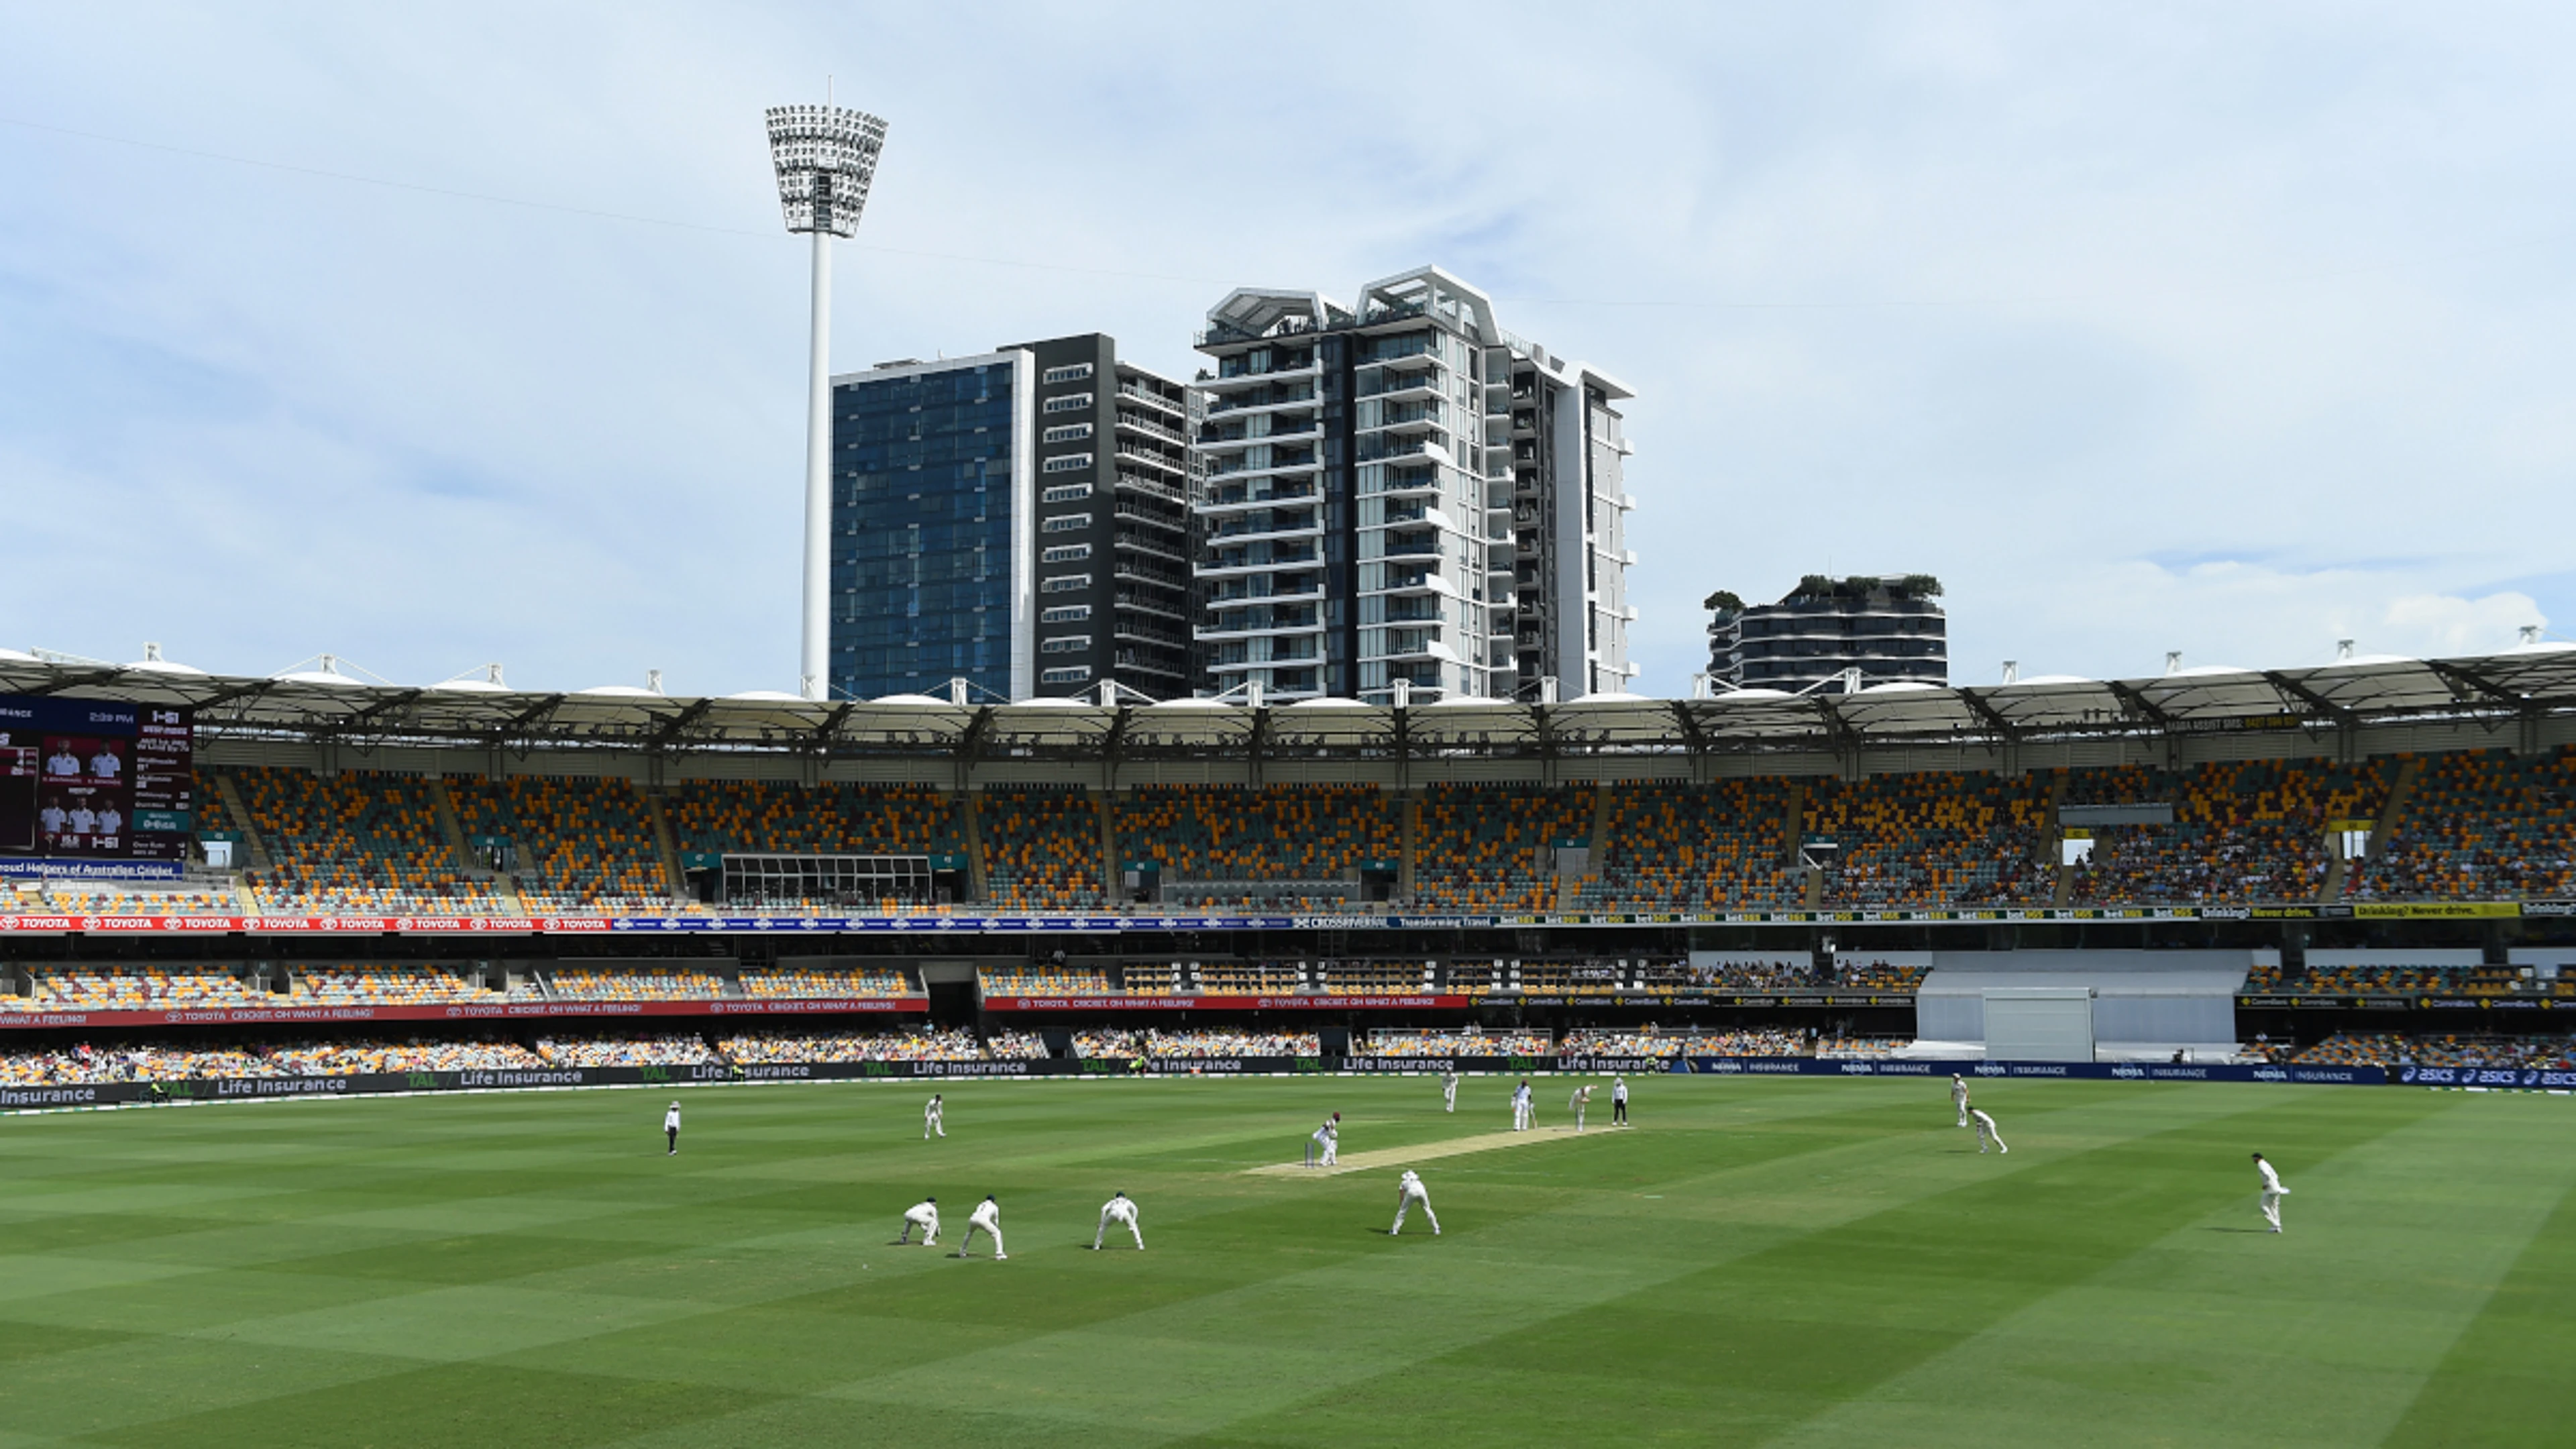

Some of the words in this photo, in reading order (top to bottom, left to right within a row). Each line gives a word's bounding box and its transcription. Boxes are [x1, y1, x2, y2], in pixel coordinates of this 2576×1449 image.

[2412, 906, 2443, 915] Never
[21, 918, 70, 928] TOYOTA
[104, 918, 152, 928] TOYOTA
[185, 918, 231, 928] TOYOTA
[264, 919, 309, 928] TOYOTA
[341, 919, 384, 928] TOYOTA
[416, 920, 460, 928] TOYOTA
[490, 920, 533, 928] TOYOTA
[185, 1012, 226, 1020] TOYOTA
[292, 1010, 321, 1018] WHAT
[333, 1009, 374, 1017] FEELING!
[863, 1063, 893, 1075] TAL
[914, 1062, 944, 1074] Life
[948, 1061, 1026, 1074] Insurance
[1080, 1060, 1110, 1072] TAL
[1164, 1059, 1241, 1071] Insurance
[1294, 1059, 1324, 1070] TAL
[1343, 1058, 1373, 1070] Life
[1378, 1058, 1454, 1070] Insurance
[1507, 1058, 1537, 1070] TAL
[1558, 1058, 1589, 1069] Life
[1750, 1061, 1799, 1072] INSURANCE
[1880, 1064, 1929, 1073] INSURANCE
[640, 1067, 670, 1080] TAL
[692, 1065, 723, 1079] Life
[728, 1065, 809, 1077] Isurance
[2014, 1066, 2066, 1075] INSURANCE
[2152, 1069, 2206, 1078] INSURANCE
[2295, 1071, 2353, 1081] INSURANCE
[407, 1073, 438, 1087] TAL
[462, 1071, 494, 1085] Life
[498, 1069, 582, 1083] Insurance
[218, 1081, 252, 1094] Life
[258, 1077, 346, 1093] Insurance
